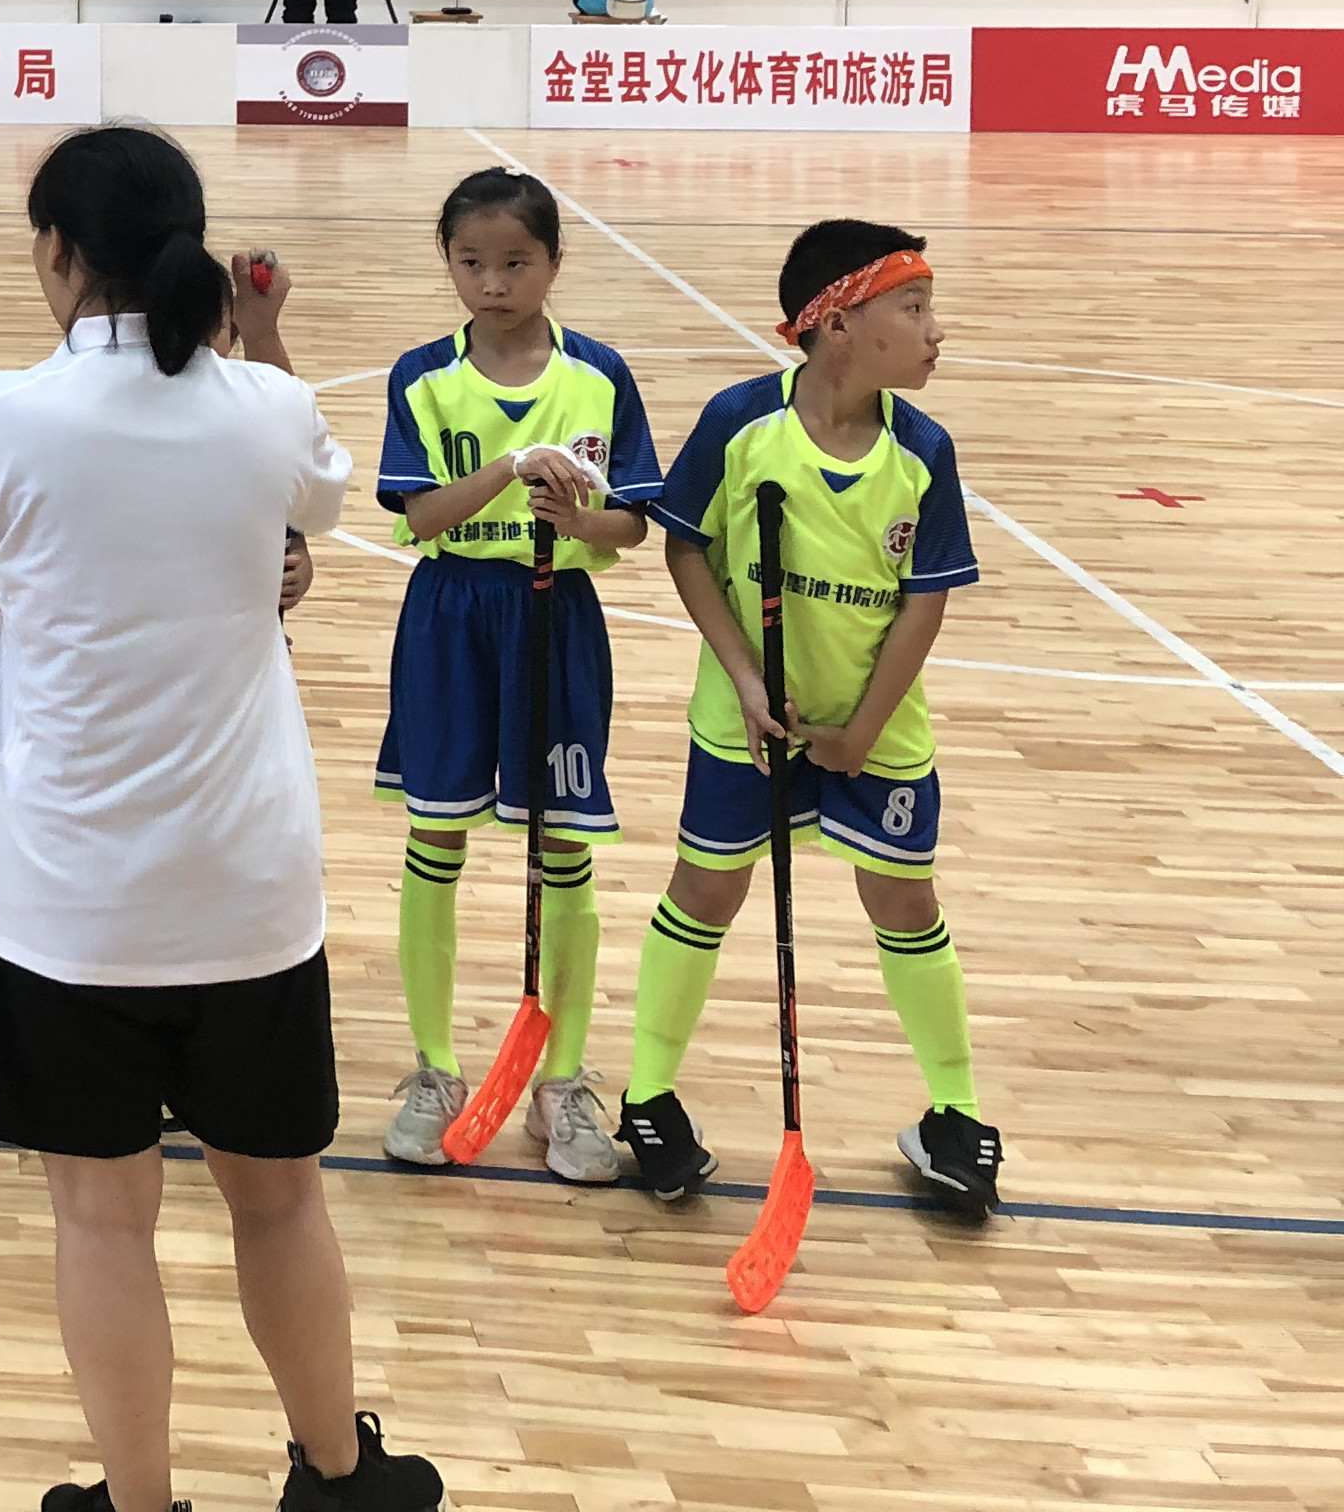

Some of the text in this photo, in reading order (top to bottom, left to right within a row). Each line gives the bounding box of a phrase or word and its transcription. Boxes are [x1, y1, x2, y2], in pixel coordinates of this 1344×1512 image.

[544, 49, 953, 106] 金堂县文化体育和旅游局
[1106, 45, 1301, 93] HMedia
[1106, 94, 1300, 119] 虎马传媒
[440, 427, 481, 481] 10
[547, 743, 592, 798] 10
[882, 787, 916, 836] 8
